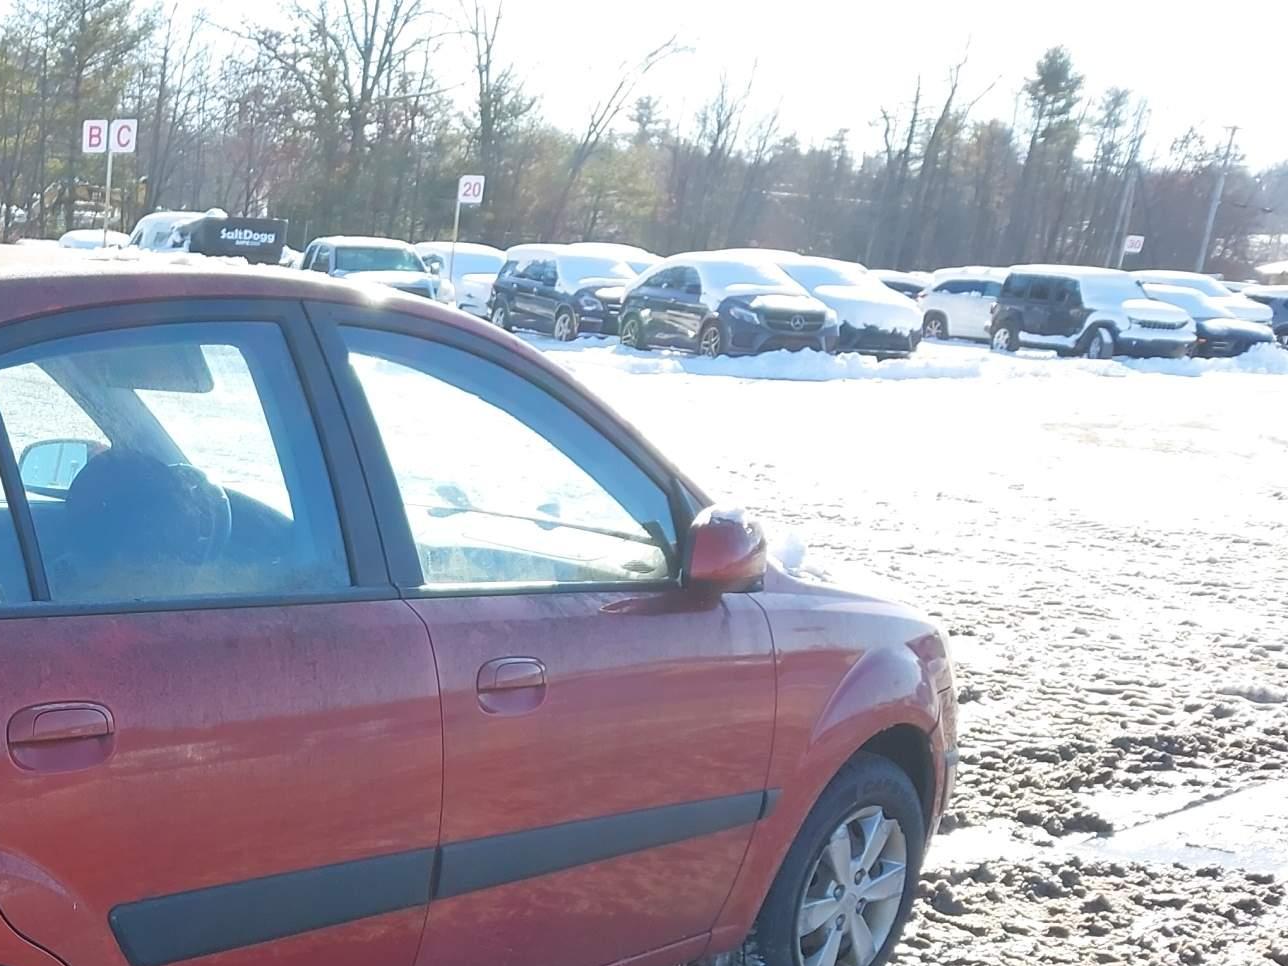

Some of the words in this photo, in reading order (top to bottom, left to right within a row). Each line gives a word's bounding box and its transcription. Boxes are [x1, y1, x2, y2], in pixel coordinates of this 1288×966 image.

[89, 126, 102, 148] B
[117, 125, 131, 148] C
[463, 182, 482, 197] 20
[220, 228, 276, 244] SaltDogg
